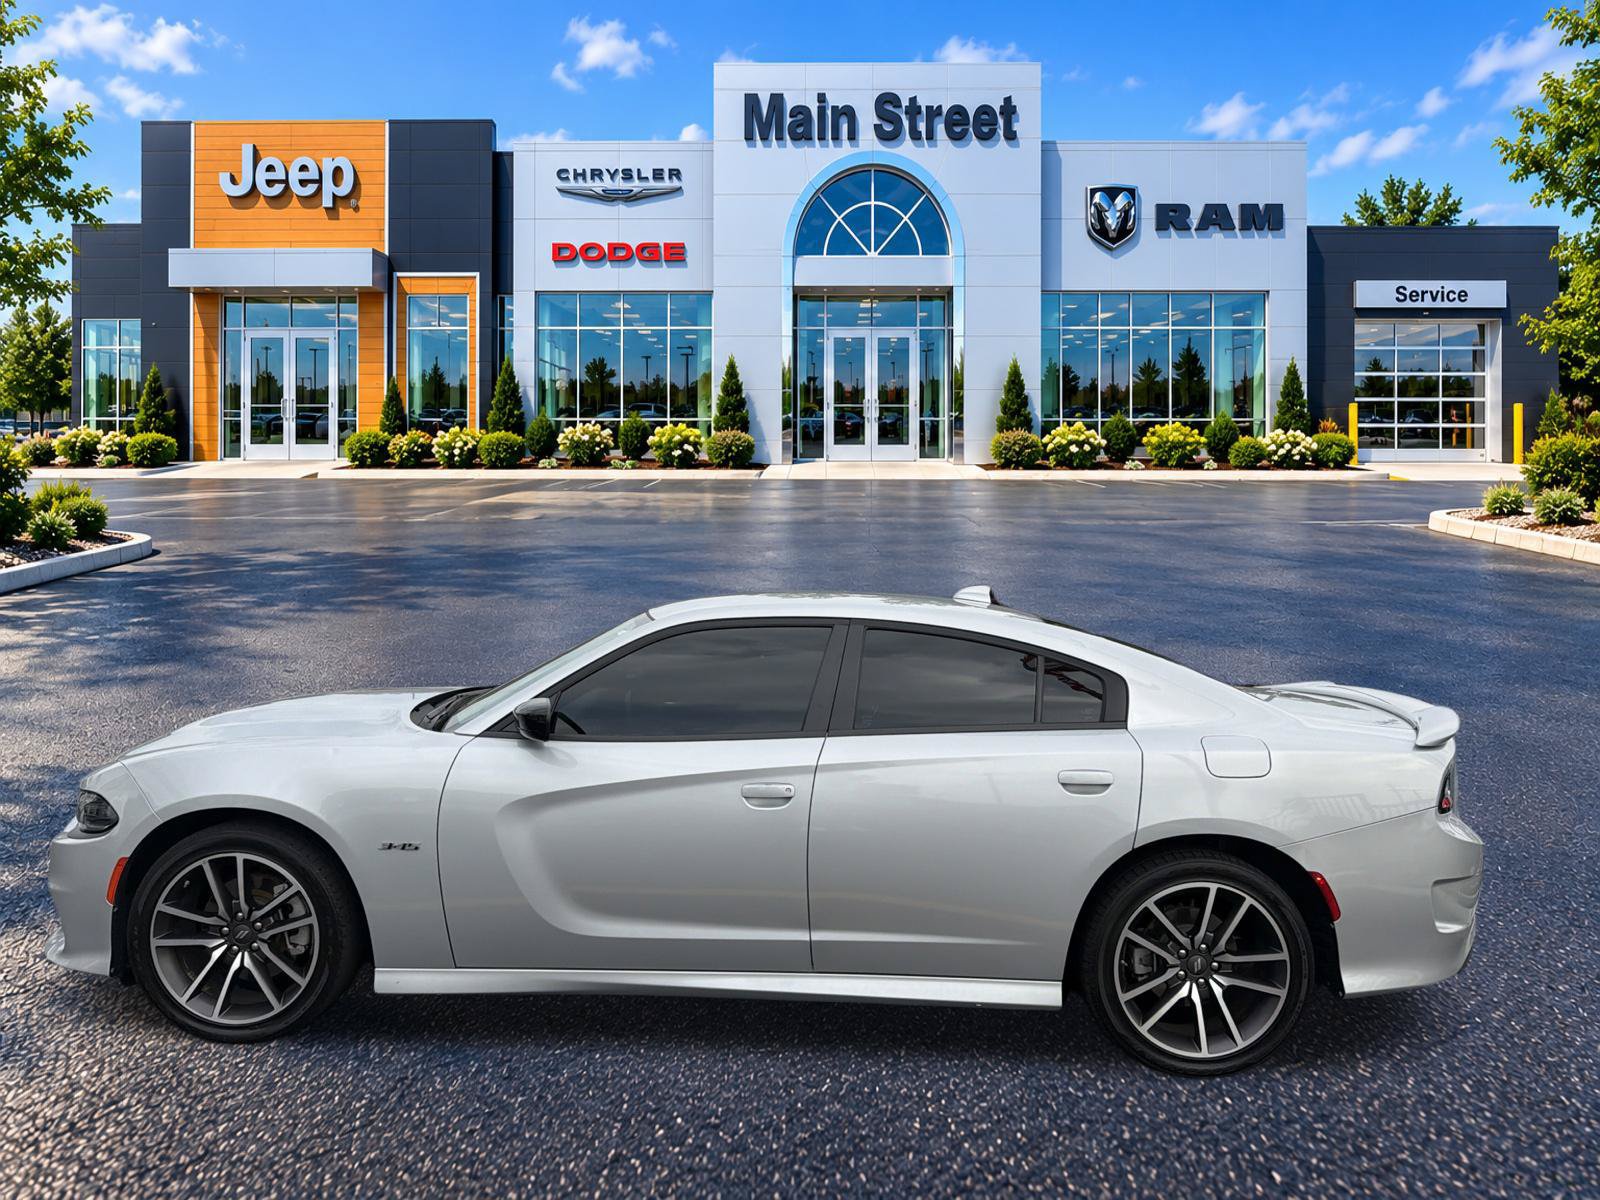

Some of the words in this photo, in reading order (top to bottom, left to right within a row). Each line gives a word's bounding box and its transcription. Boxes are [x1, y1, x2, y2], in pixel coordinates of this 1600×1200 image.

[744, 92, 857, 141] Main
[873, 91, 1018, 142] Street
[218, 143, 355, 209] Jeep
[555, 167, 683, 182] CHRYSLER
[1154, 203, 1285, 232] RAM
[551, 241, 687, 262] DODGE
[1395, 285, 1469, 303] Service
